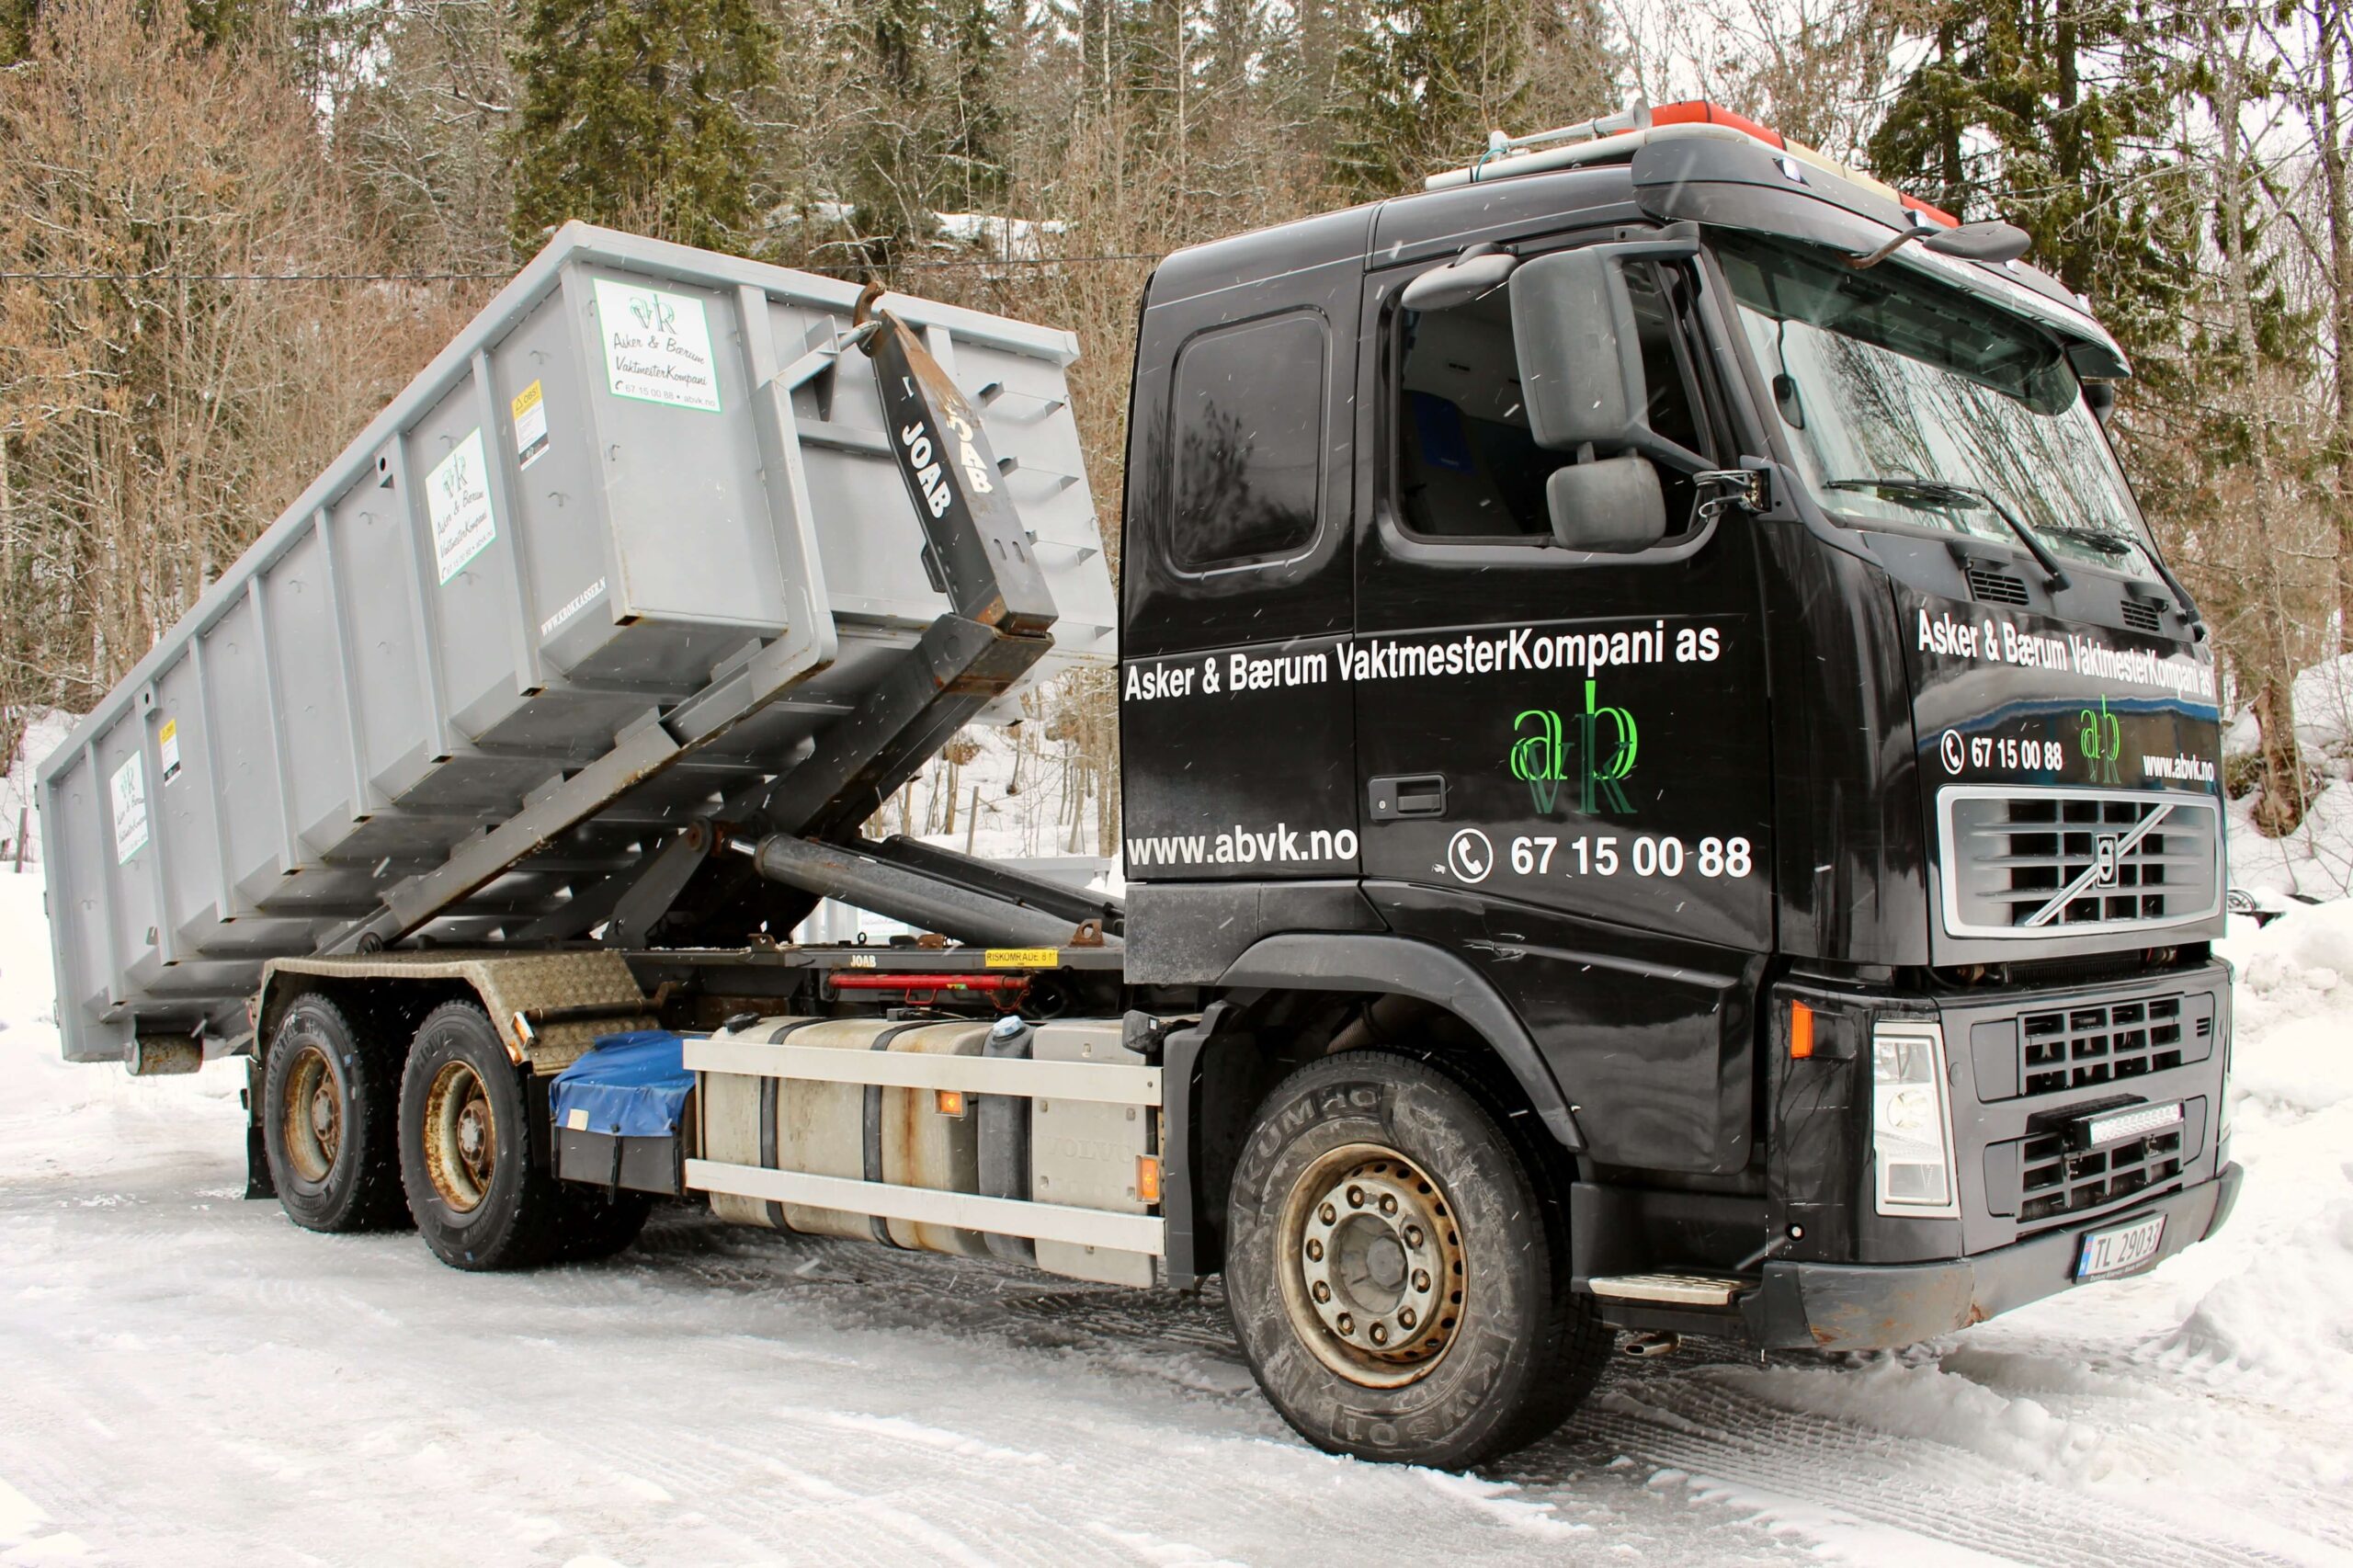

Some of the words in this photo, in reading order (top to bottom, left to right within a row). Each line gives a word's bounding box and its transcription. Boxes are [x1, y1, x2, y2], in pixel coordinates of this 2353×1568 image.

[614, 333, 642, 350] Asker
[648, 335, 660, 348] &
[615, 355, 708, 387] VaktmesterKompani
[625, 384, 635, 393] 67
[639, 386, 649, 395] 15
[650, 388, 662, 398] 00
[943, 397, 993, 494] OAB
[902, 421, 951, 518] JOAB
[1124, 662, 1195, 700] Asker
[1202, 656, 1221, 694] &
[1230, 653, 1327, 691] Bærum
[1336, 619, 1664, 681] VaktmesterKompani
[1676, 627, 1720, 663] as
[1918, 608, 1979, 659] Asker
[1984, 619, 2001, 662] &
[2002, 622, 2068, 671] Bærum
[2068, 634, 2200, 699] VaktmesterKompani
[2199, 669, 2212, 699] as
[1971, 736, 1993, 768] 67
[1997, 738, 2018, 769] 15
[2021, 739, 2041, 770] 00
[2043, 741, 2063, 771] 88
[2143, 752, 2215, 782] www.abvk.no
[1126, 823, 1358, 866] www.abvk.no
[1511, 835, 1558, 875] 67
[1571, 835, 1619, 876] 15
[1632, 836, 1684, 877] 00
[1698, 836, 1752, 878] 88
[850, 955, 877, 968] JOAB
[1038, 1131, 1134, 1164] VOLVO
[2096, 1236, 2111, 1269] TL
[2117, 1221, 2160, 1263] 29033
